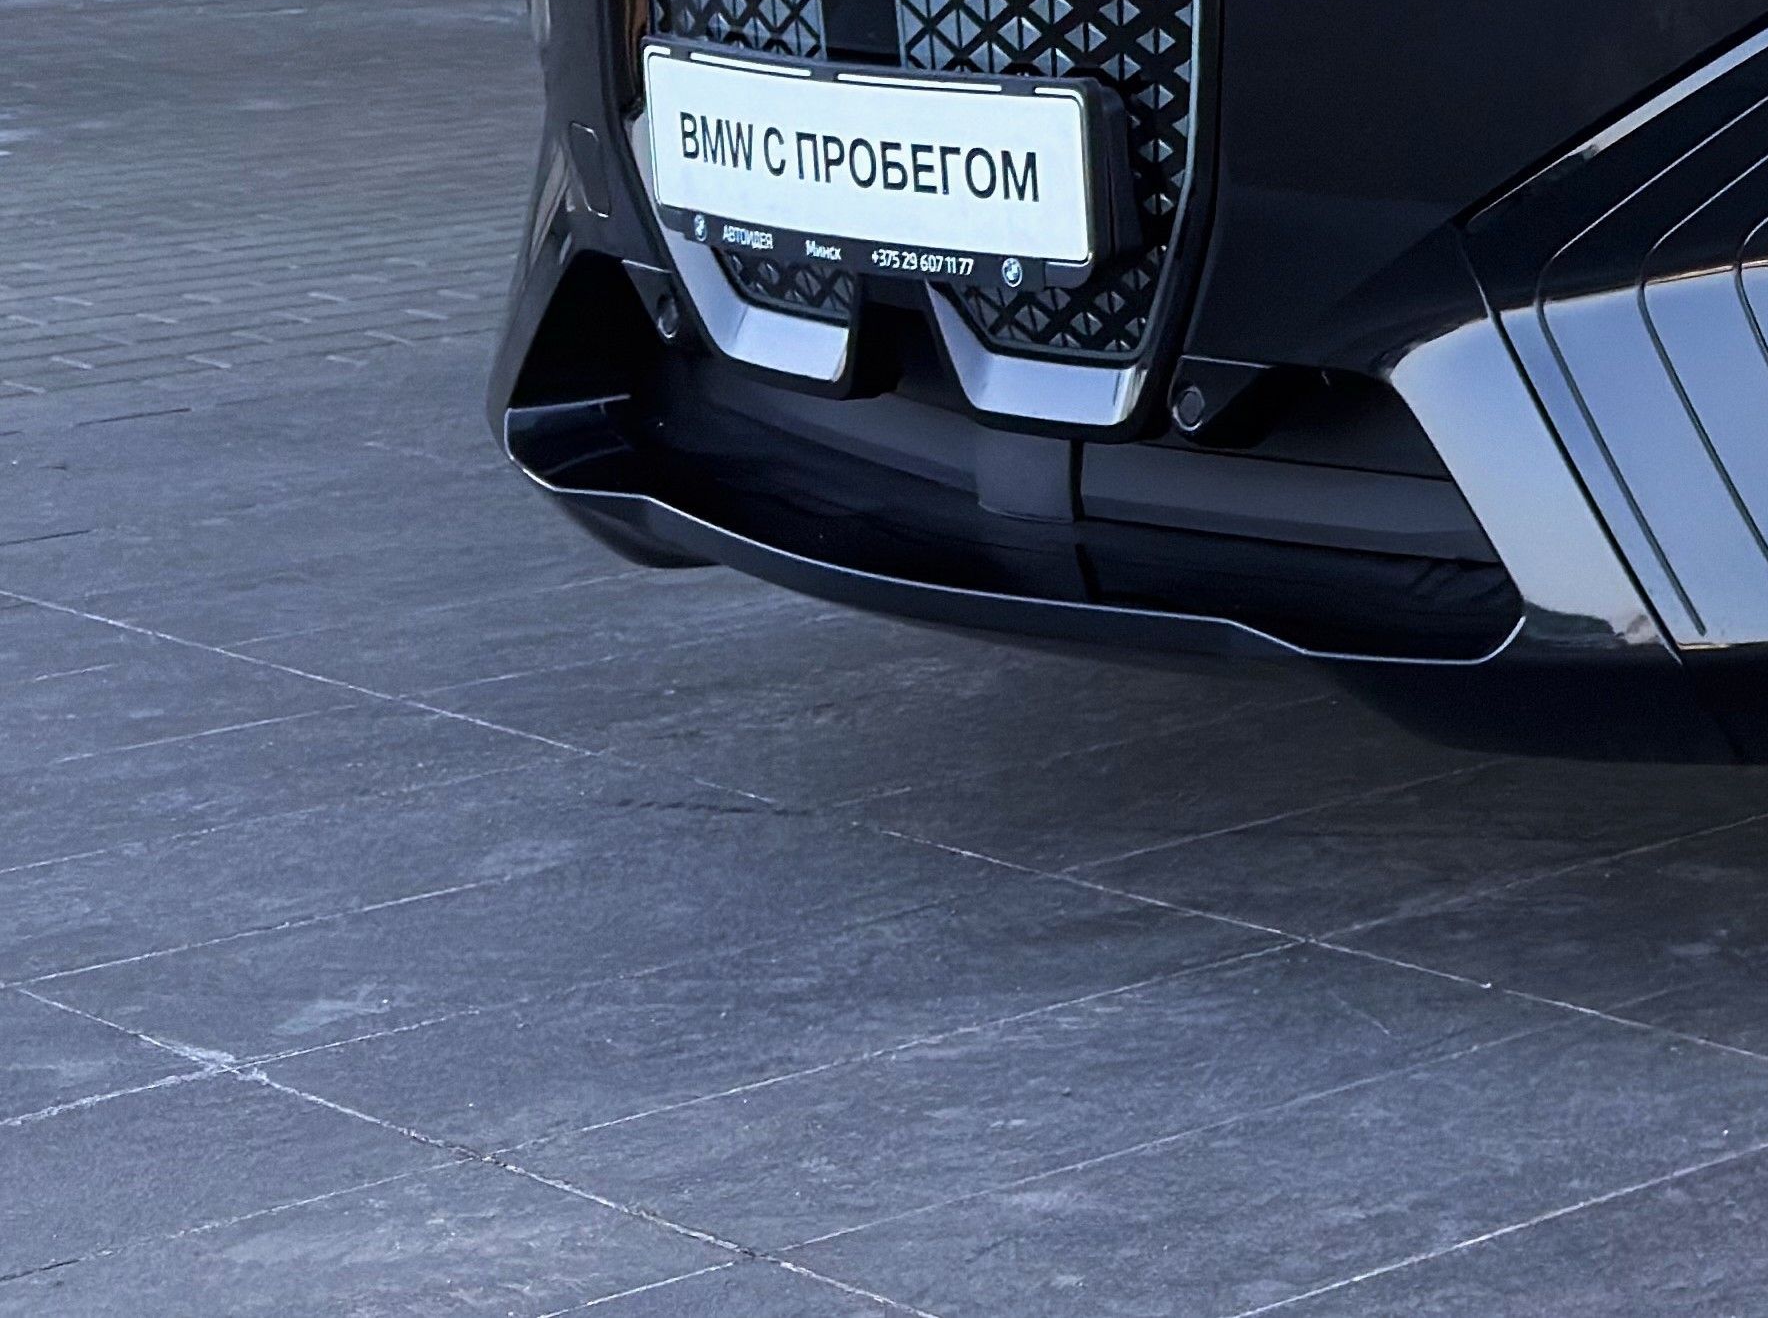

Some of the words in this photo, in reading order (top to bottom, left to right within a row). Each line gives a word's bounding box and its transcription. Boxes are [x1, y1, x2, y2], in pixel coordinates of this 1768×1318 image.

[680, 112, 753, 170] BMW
[764, 127, 785, 176] С
[796, 132, 1039, 202] ПРОБЕГОМ
[722, 225, 773, 249] АВТОИДЕЯ
[805, 240, 841, 260] Минск
[871, 249, 899, 269] +375
[902, 252, 917, 270] 29
[920, 254, 943, 272] 607
[945, 256, 957, 274] 11
[958, 258, 974, 275] 77
